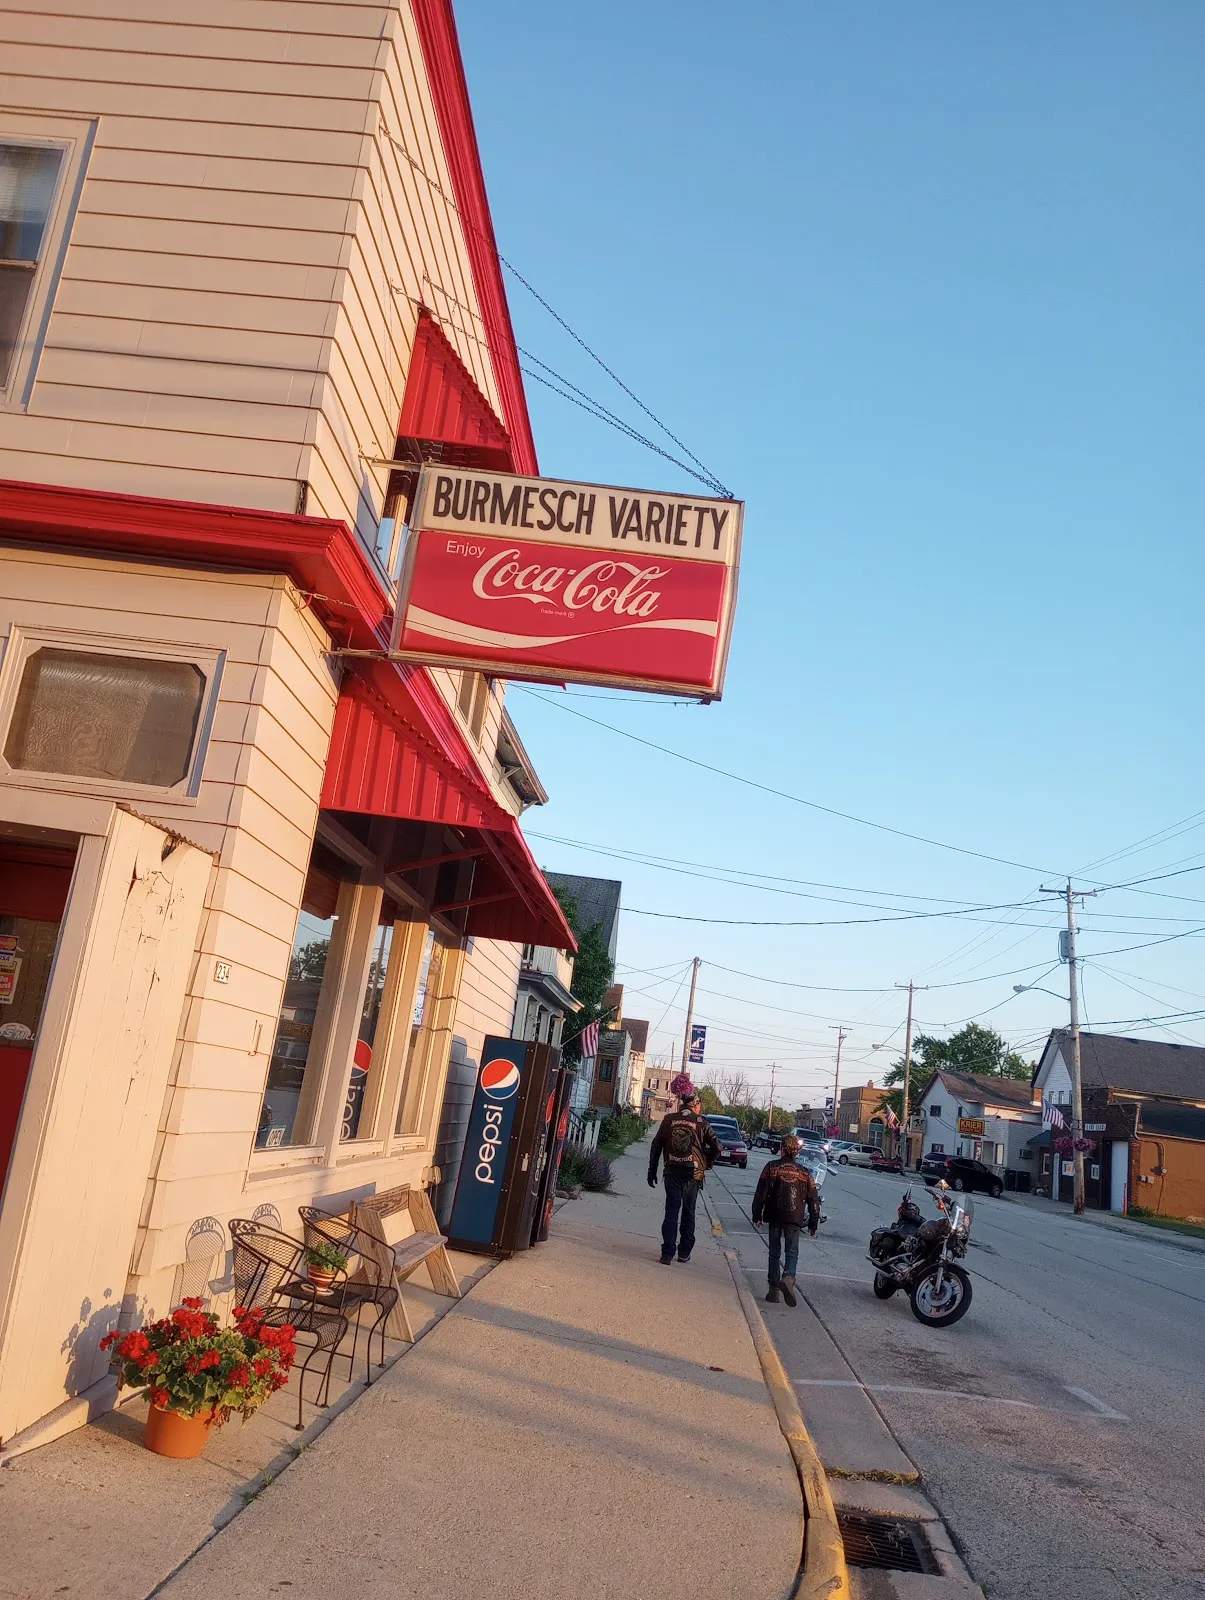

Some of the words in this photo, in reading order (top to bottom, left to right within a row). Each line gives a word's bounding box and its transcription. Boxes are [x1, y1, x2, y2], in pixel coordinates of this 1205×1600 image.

[432, 476, 596, 536] BURMESCH
[608, 495, 730, 551] VARIETY
[446, 540, 486, 559] Enjoy
[472, 548, 673, 617] Coca-Cola
[217, 964, 230, 981] 234
[475, 1104, 504, 1184] pepsi
